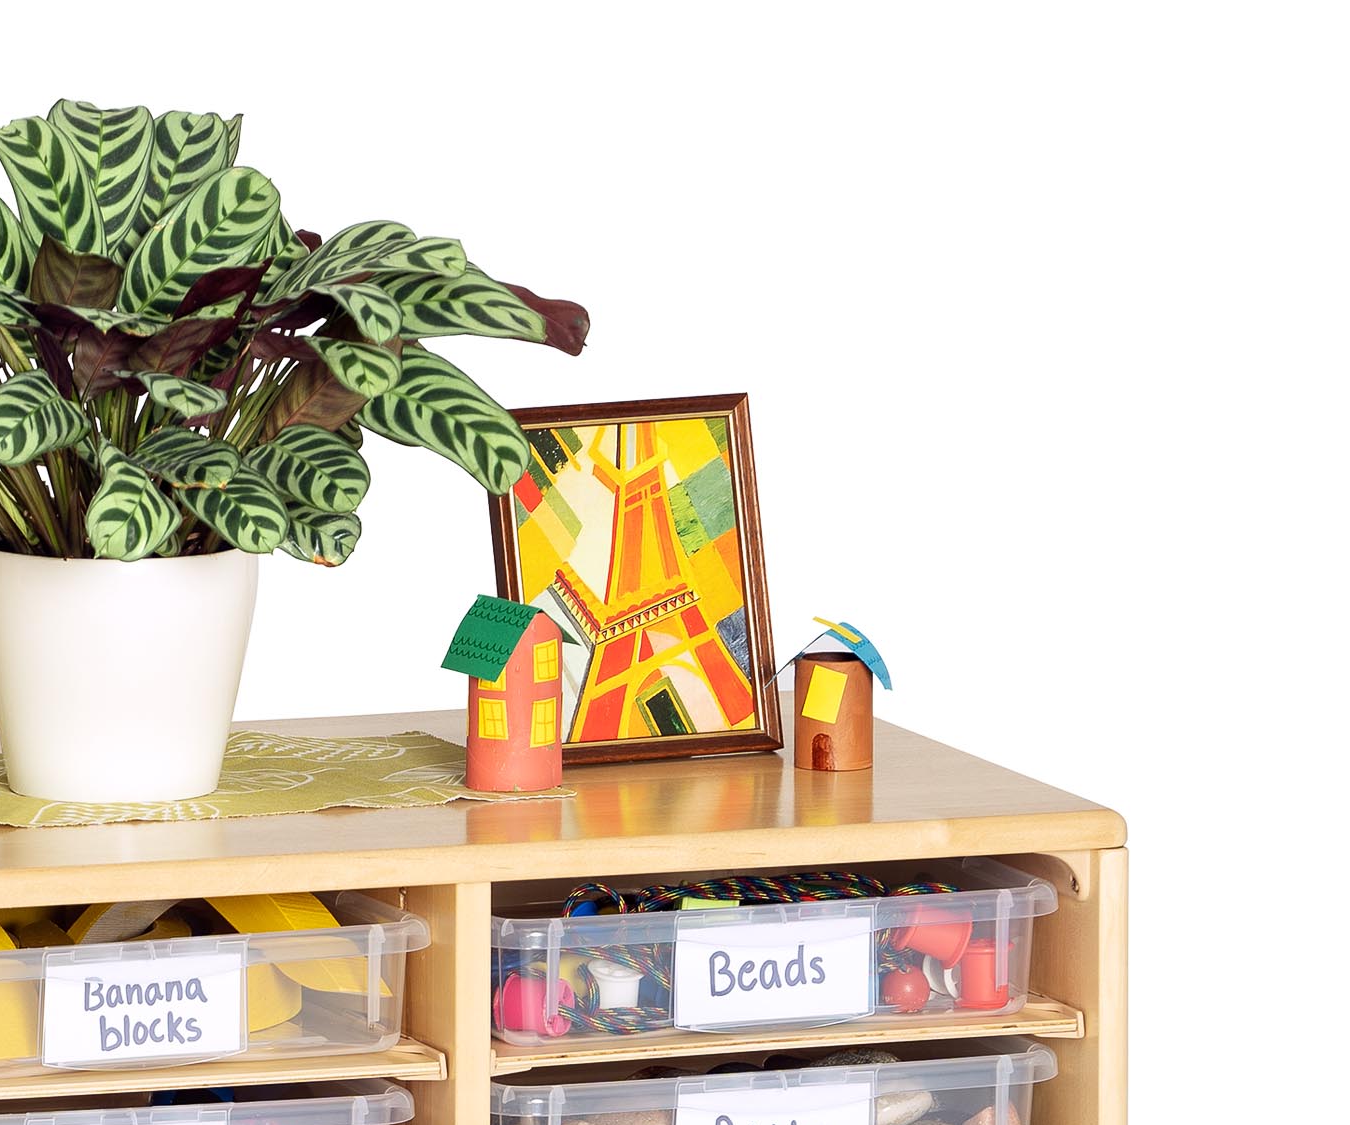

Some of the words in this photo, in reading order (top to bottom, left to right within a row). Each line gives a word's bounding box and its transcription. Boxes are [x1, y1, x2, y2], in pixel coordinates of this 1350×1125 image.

[708, 945, 826, 997] Beads
[84, 977, 208, 1011] Banana
[99, 1011, 203, 1051] blocks
